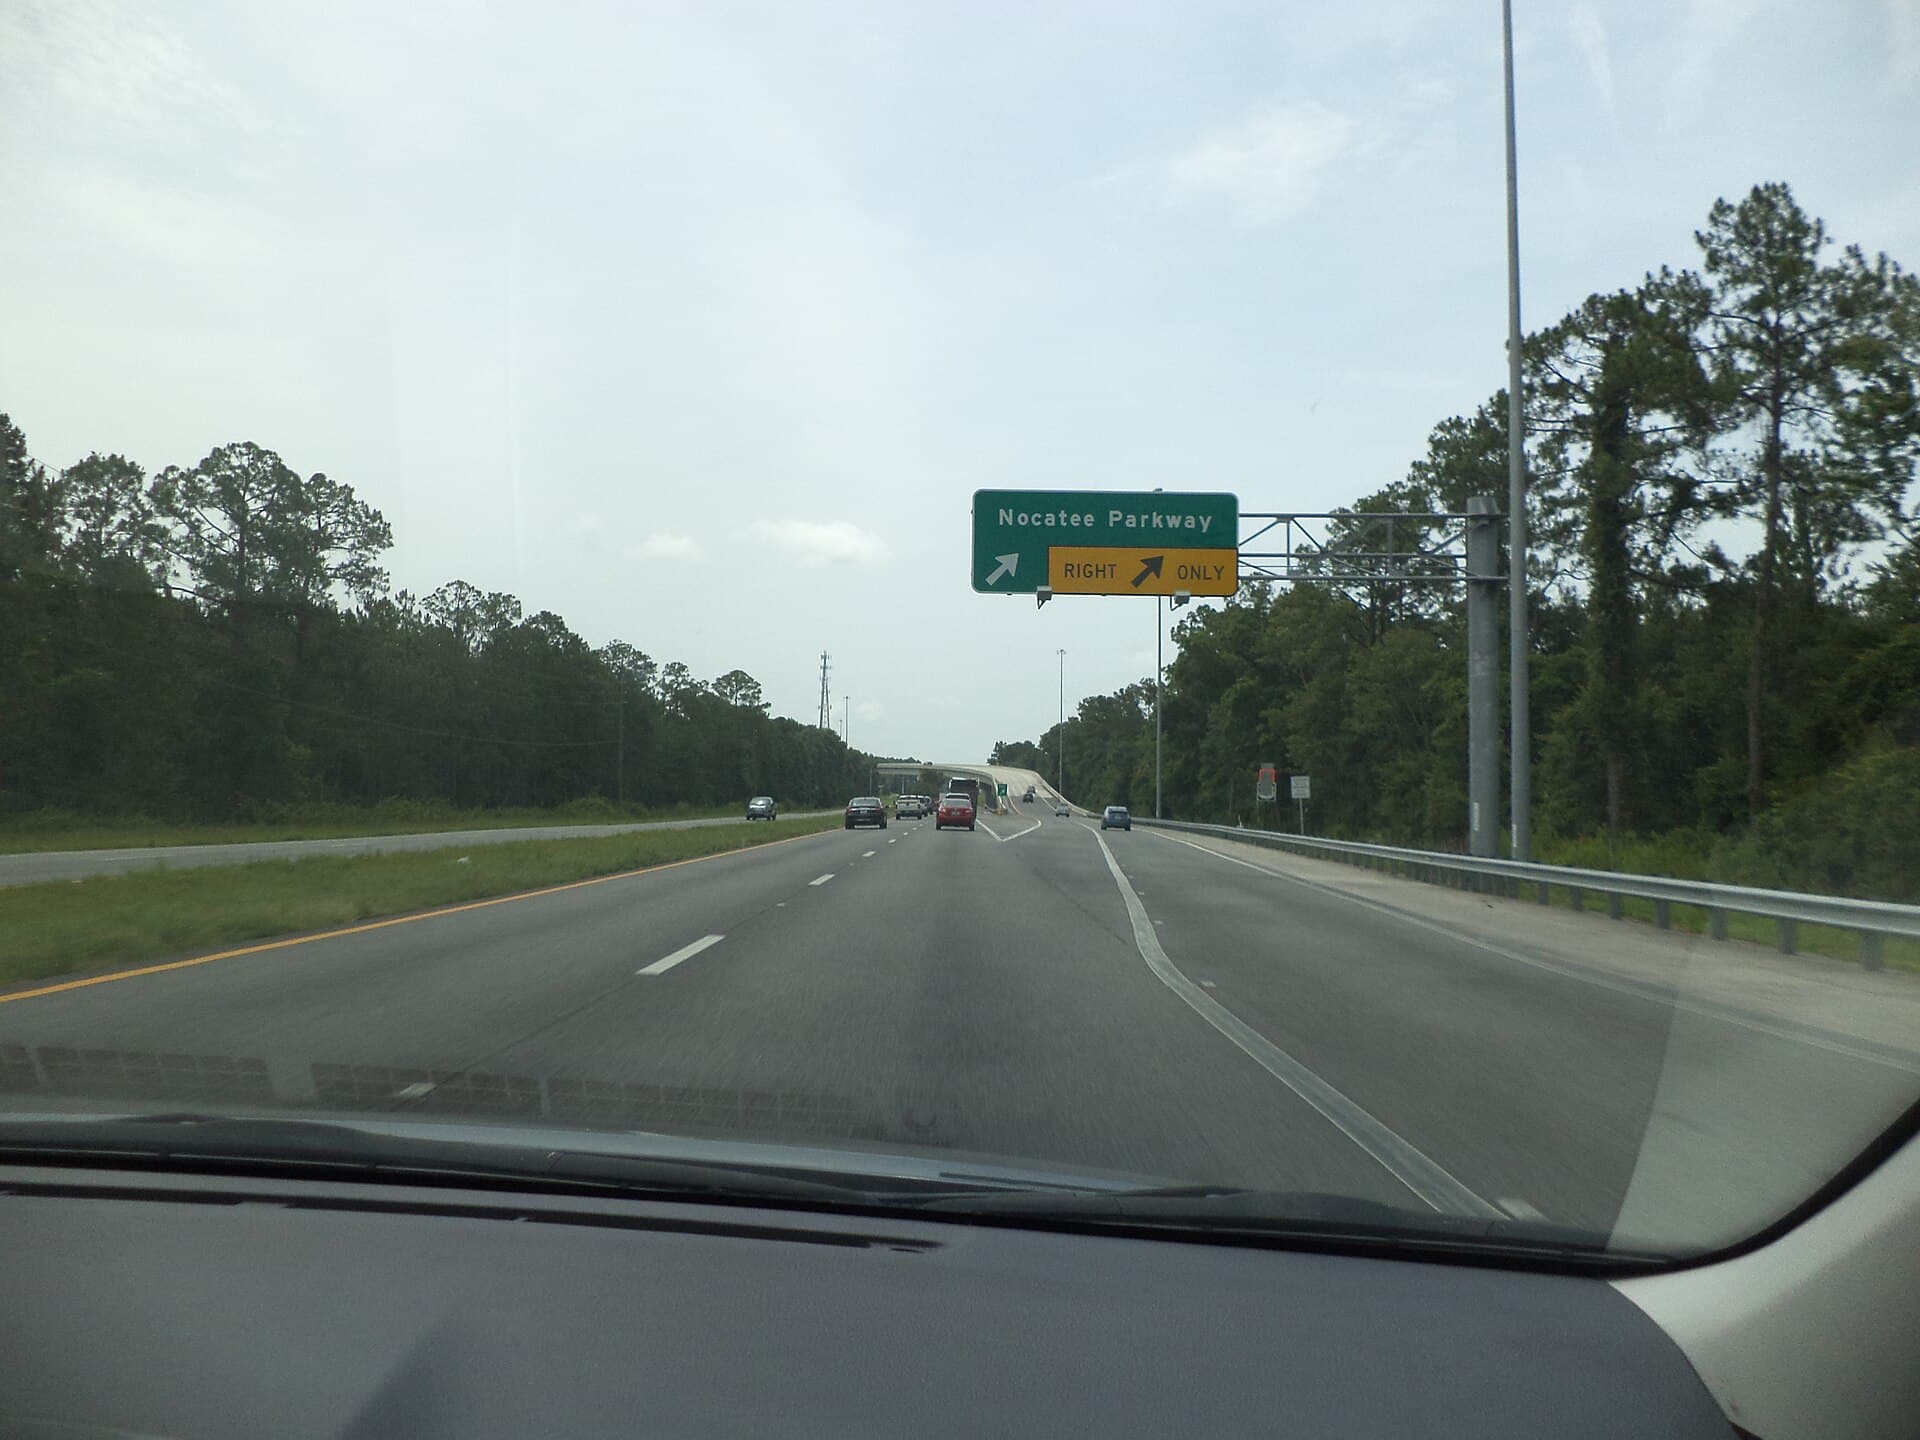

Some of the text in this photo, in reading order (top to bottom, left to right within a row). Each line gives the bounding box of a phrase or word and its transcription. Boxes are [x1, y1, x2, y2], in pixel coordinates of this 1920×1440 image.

[999, 509, 1213, 533] Nocatee Parkway
[1064, 563, 1225, 581] RIGHT ONLY
